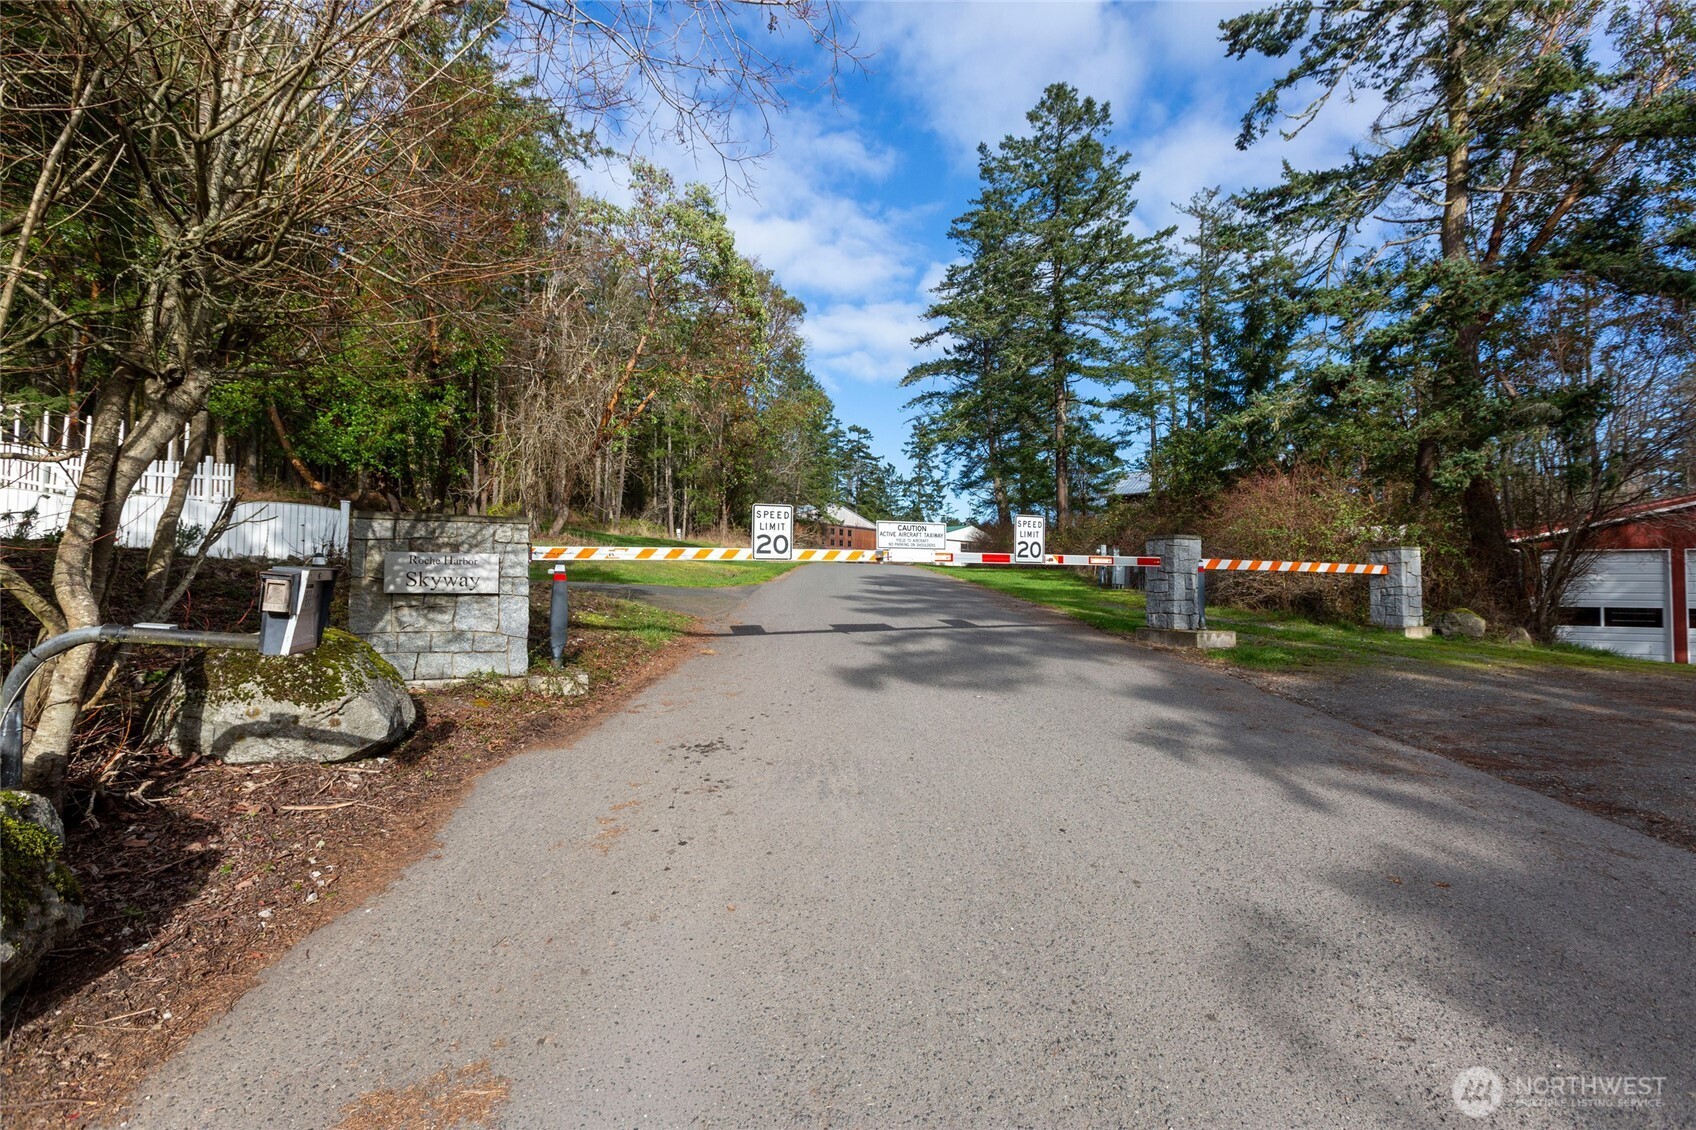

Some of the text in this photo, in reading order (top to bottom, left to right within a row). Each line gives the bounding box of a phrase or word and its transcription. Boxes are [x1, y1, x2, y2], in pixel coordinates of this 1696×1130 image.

[756, 510, 790, 520] SPEED
[760, 522, 786, 531] LIMIT
[1017, 520, 1043, 529] SPEED
[1019, 530, 1040, 539] LIMIT
[756, 534, 789, 554] 20
[1017, 541, 1042, 559] 20
[409, 555, 478, 566] Roche Harbor
[405, 571, 481, 591] Skyway
